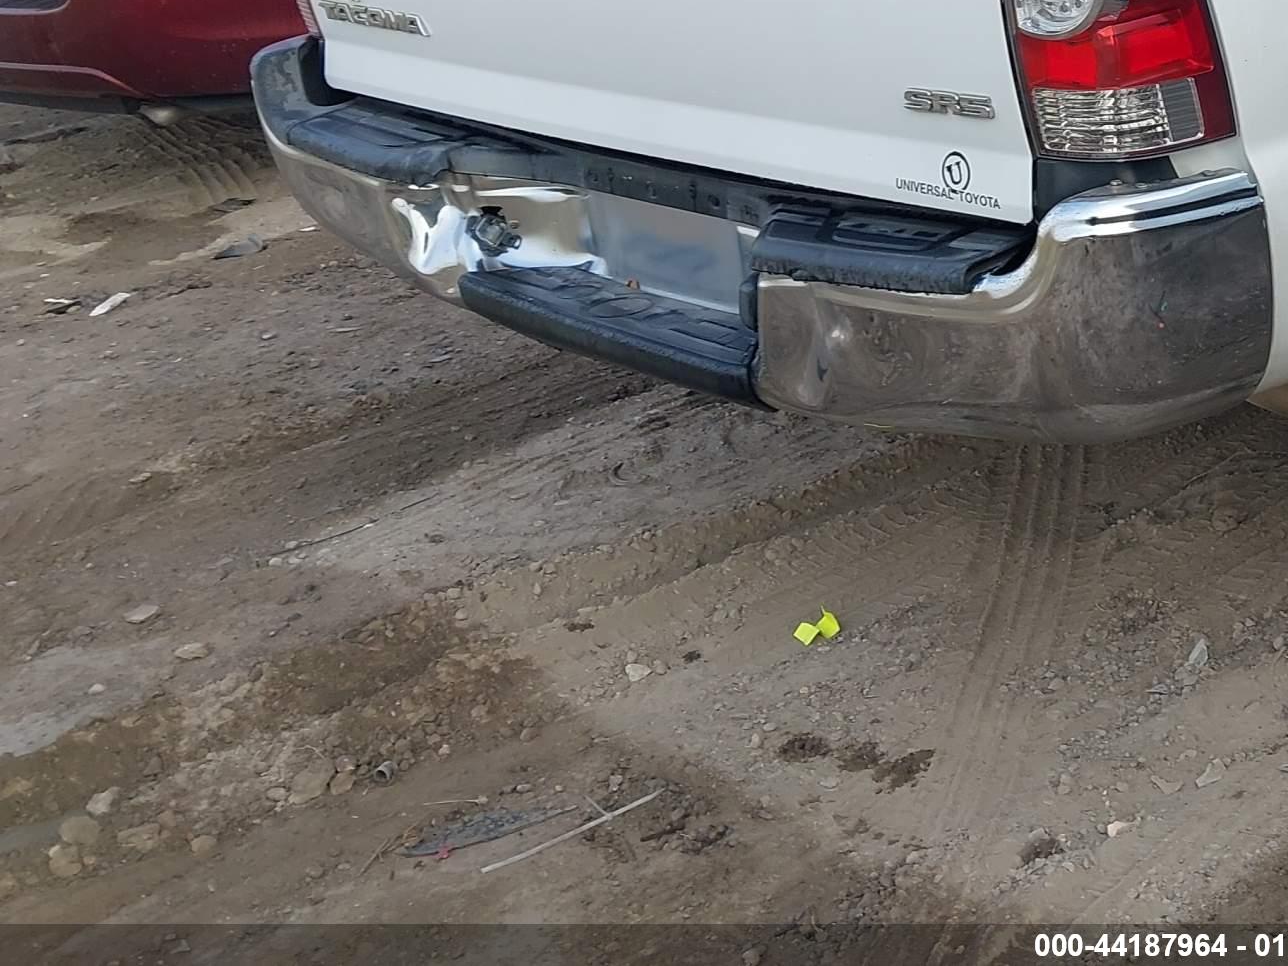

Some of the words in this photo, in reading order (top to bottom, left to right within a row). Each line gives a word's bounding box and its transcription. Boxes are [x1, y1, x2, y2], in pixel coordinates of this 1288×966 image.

[318, 0, 431, 37] TACOMA
[903, 88, 996, 119] SR5
[895, 177, 955, 200] UNIVERSAL
[958, 190, 1001, 210] TOYOTA
